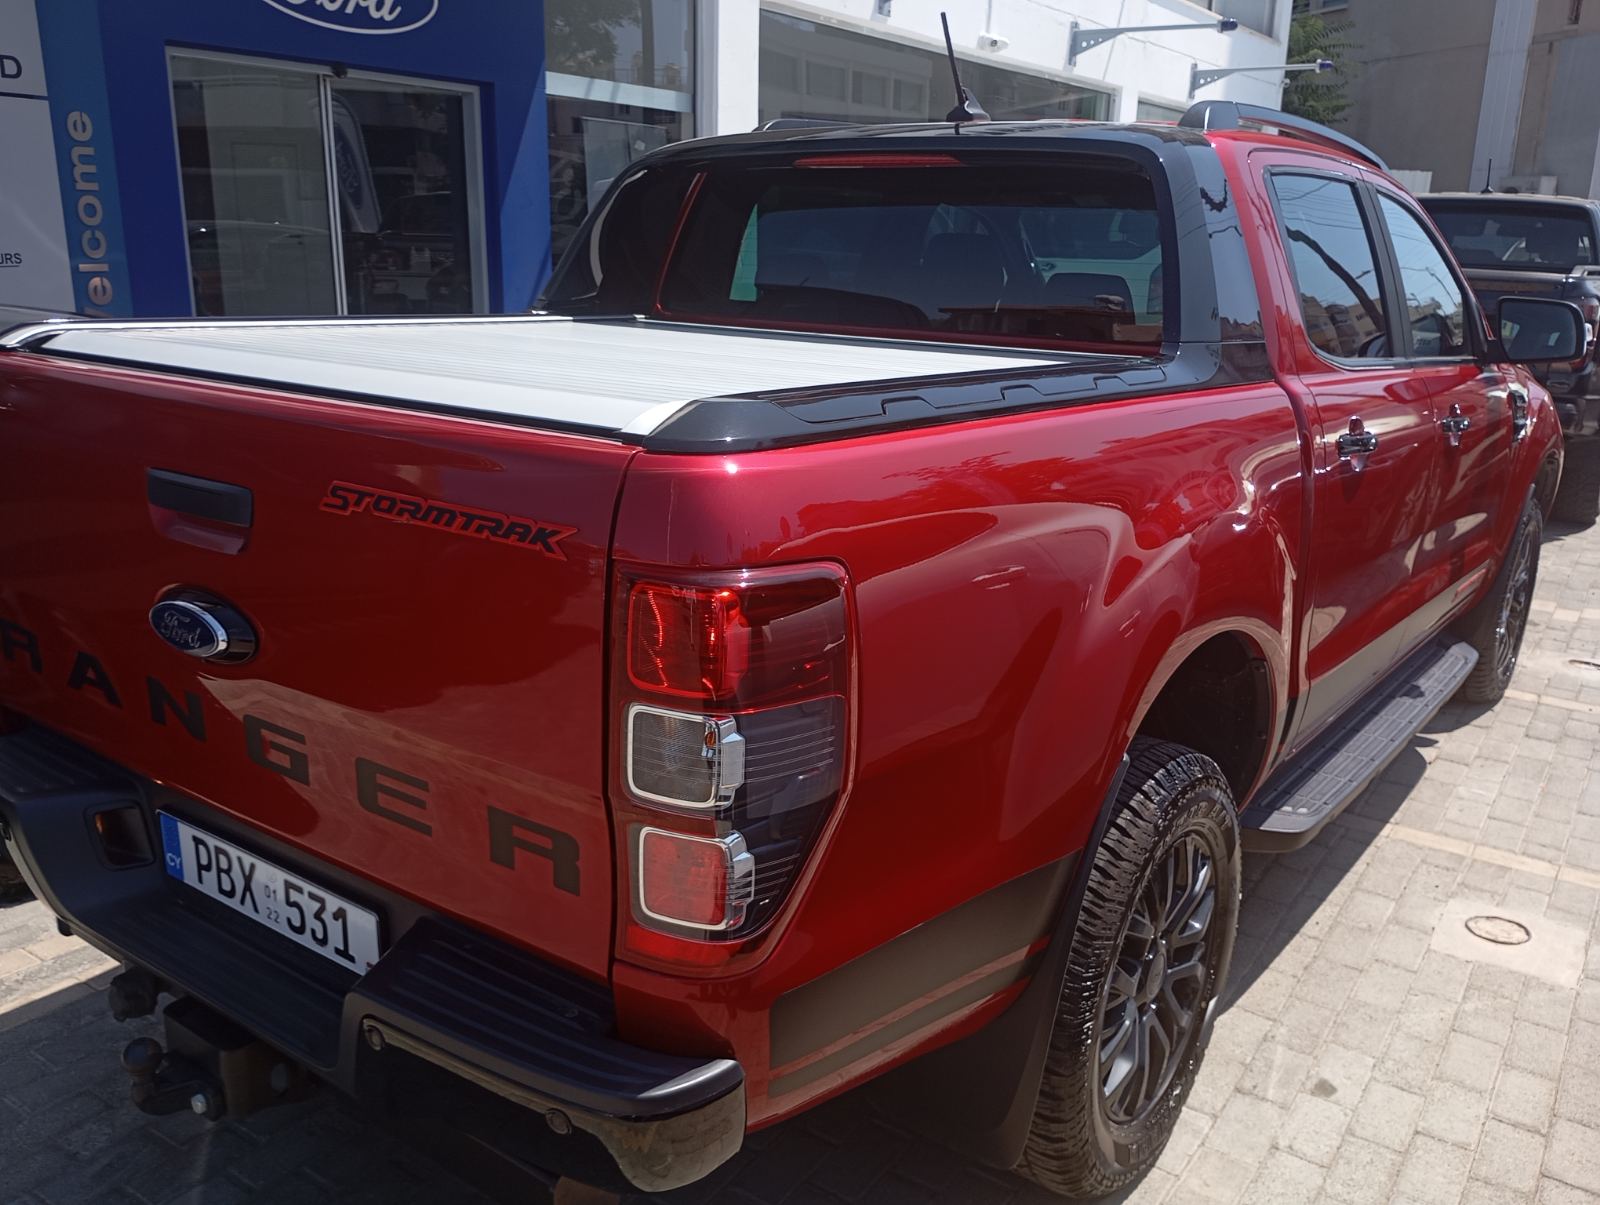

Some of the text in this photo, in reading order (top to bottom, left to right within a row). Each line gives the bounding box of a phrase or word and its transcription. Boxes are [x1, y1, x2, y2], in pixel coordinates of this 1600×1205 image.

[320, 481, 575, 560] STORMTRAK
[161, 610, 202, 648] Ford
[0, 618, 581, 896] RANGER
[166, 852, 181, 869] CY
[192, 835, 356, 963] PBX 531
[263, 884, 278, 902] 01
[265, 906, 280, 924] 22
